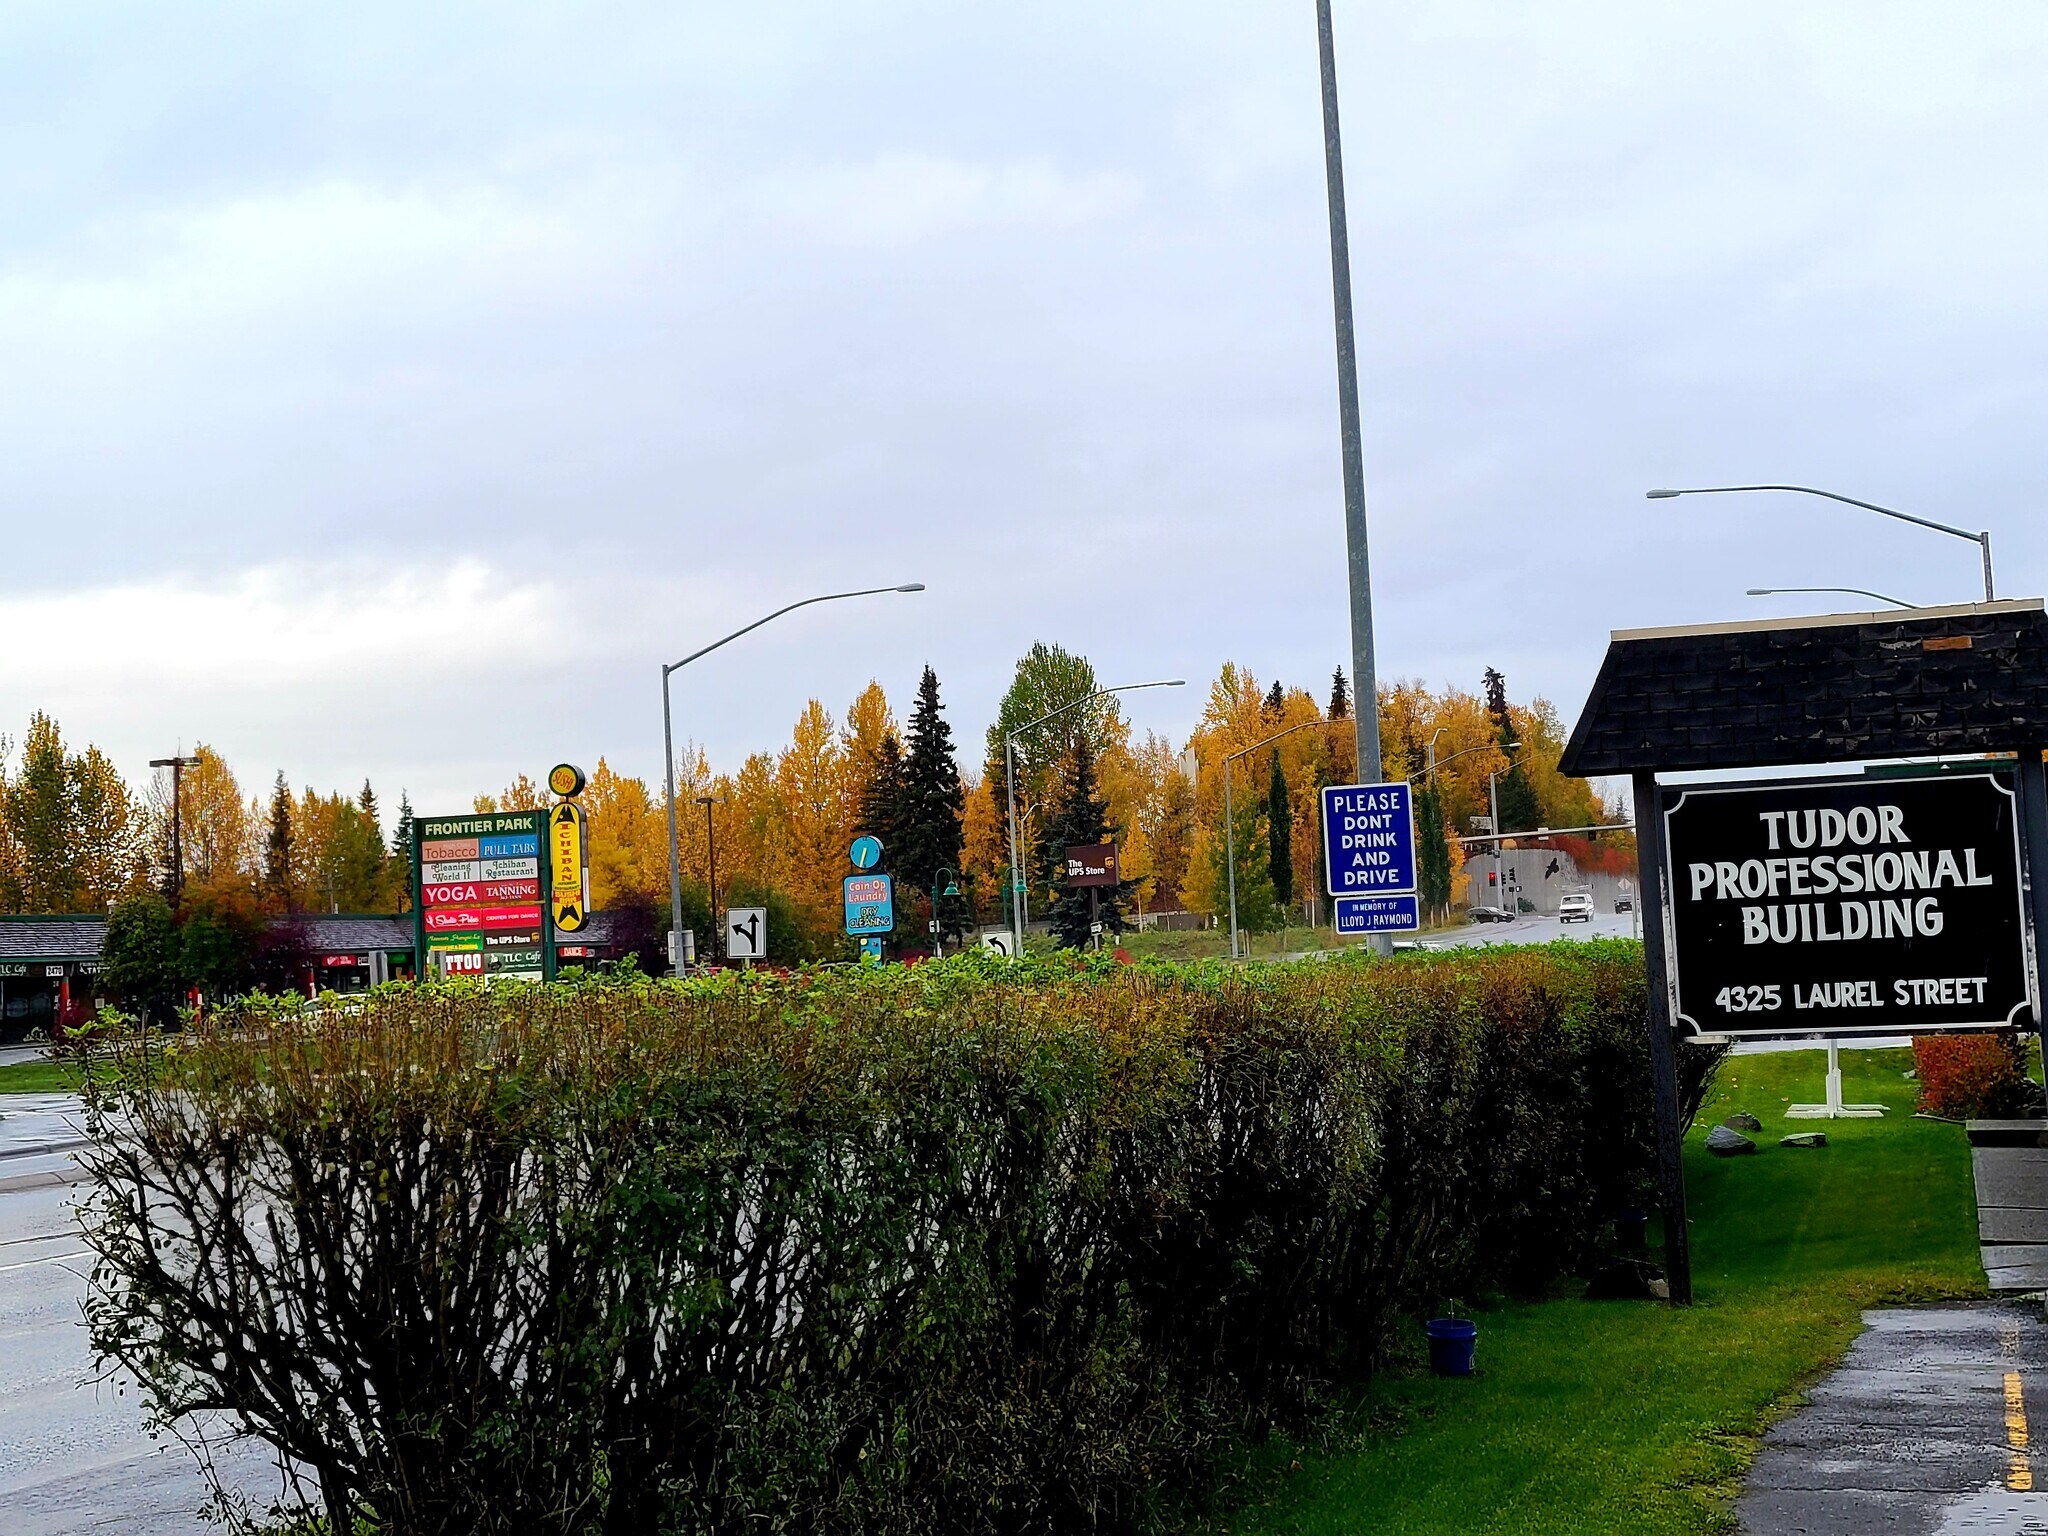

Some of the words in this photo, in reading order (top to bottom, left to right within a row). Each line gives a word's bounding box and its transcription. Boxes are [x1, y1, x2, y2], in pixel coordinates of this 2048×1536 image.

[553, 771, 574, 791] SUSHI
[1334, 792, 1400, 813] PLEASE
[425, 820, 492, 836] FRONTIER
[496, 817, 533, 831] PARK
[1344, 814, 1392, 831] DONT
[1759, 805, 1911, 850] TUDOR
[1341, 832, 1397, 849] DRINK
[425, 847, 477, 859] Tobacco
[484, 844, 508, 856] PULL
[511, 843, 535, 854] TABS
[559, 824, 573, 882] ICHIBAN
[492, 860, 526, 870] Ichiban
[1068, 860, 1082, 868] The
[1352, 851, 1390, 867] AND
[431, 862, 471, 873] Cleaning
[485, 867, 534, 879] Restaurant
[1068, 867, 1084, 876] UPS
[1085, 867, 1105, 875] Store
[431, 872, 460, 882] World
[463, 871, 471, 880] II
[1344, 868, 1400, 885] DRIVE
[1688, 848, 1993, 901] PROFESSIONAL
[425, 886, 477, 902] YOGA
[485, 884, 536, 897] TANNING
[555, 888, 581, 897] SUSHI
[848, 891, 888, 903] Laundry
[559, 896, 577, 904] BAR
[860, 905, 879, 918] DRY
[1352, 904, 1359, 912] IN
[1360, 902, 1386, 911] MEMORY
[1388, 902, 1398, 910] OF
[849, 917, 890, 928] CLEANING
[1341, 915, 1364, 927] LLOYD
[1366, 915, 1371, 926] J
[1373, 913, 1412, 926] RAYMOND
[1741, 897, 1944, 945] BUILDING
[485, 937, 498, 945] The
[499, 936, 512, 944] UPS
[513, 935, 531, 944] Store
[427, 953, 481, 971] TTOO
[503, 953, 522, 963] TLC
[1715, 984, 1781, 1012] 4325
[1794, 980, 1885, 1009] LAUREL
[1893, 977, 1988, 1006] STREET
